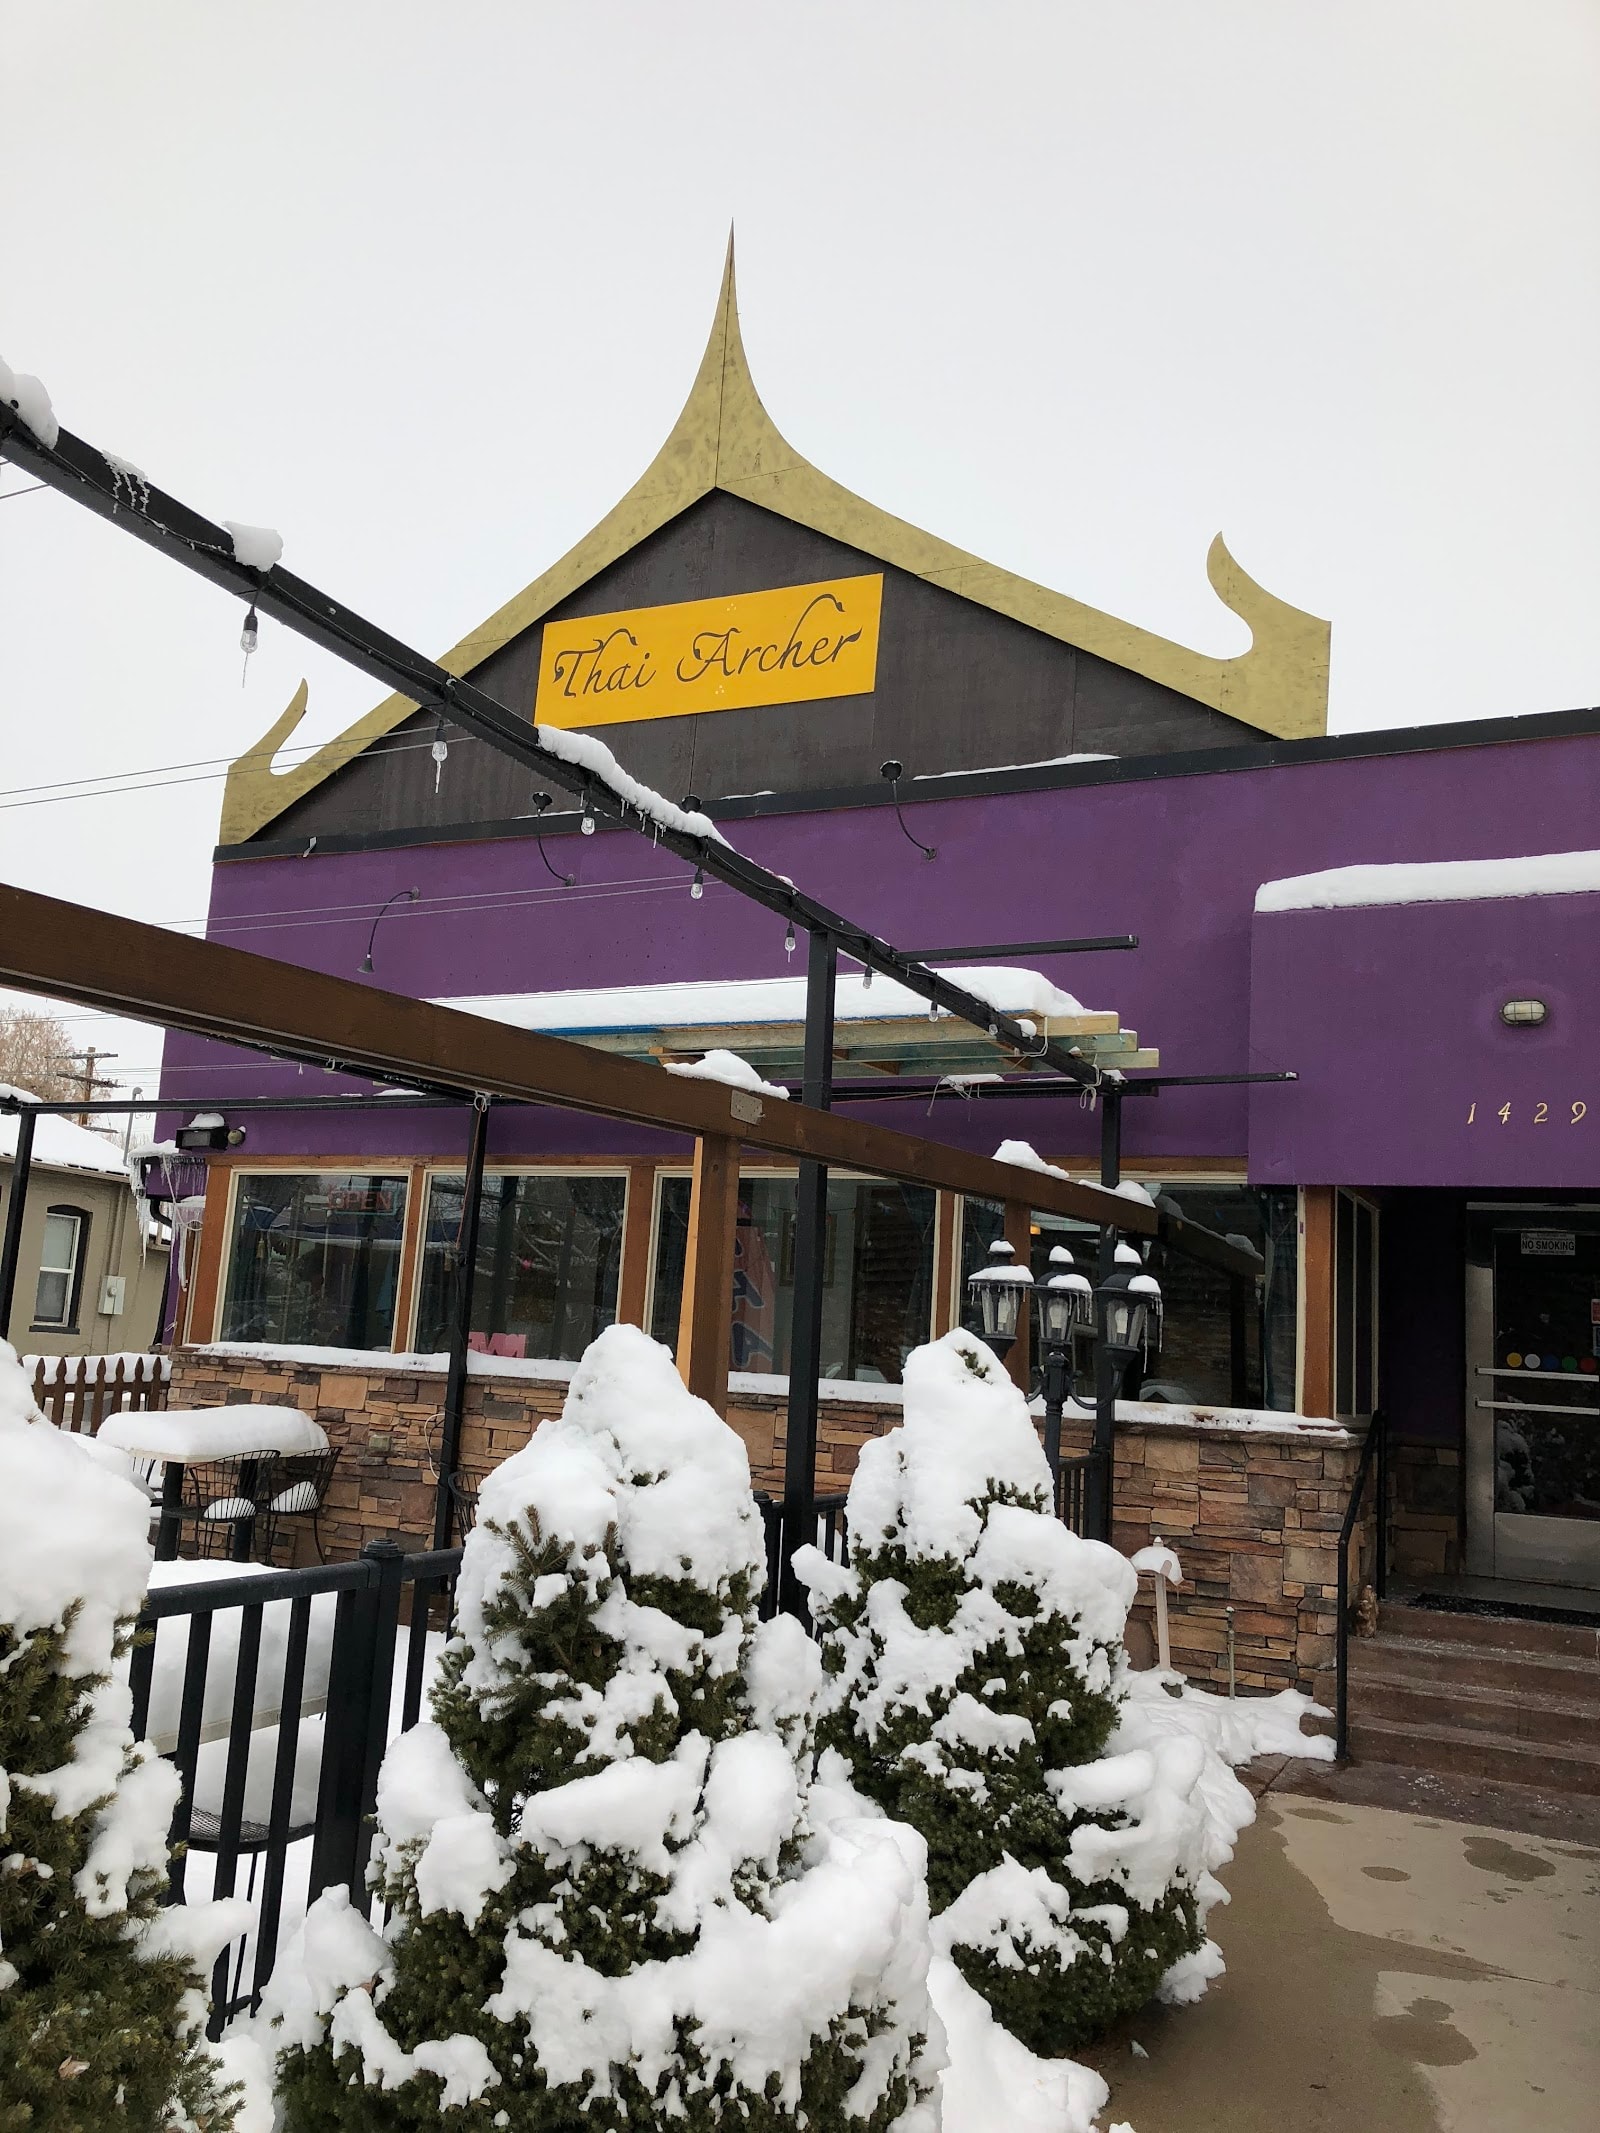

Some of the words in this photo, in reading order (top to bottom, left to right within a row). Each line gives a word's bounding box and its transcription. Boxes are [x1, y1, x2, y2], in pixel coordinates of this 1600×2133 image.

[553, 628, 656, 698] Thai
[676, 593, 863, 683] Archer
[1467, 1101, 1587, 1125] 1429
[328, 1189, 393, 1211] OPEN
[1521, 1240, 1534, 1250] NO
[1536, 1240, 1575, 1251] SMOKING
